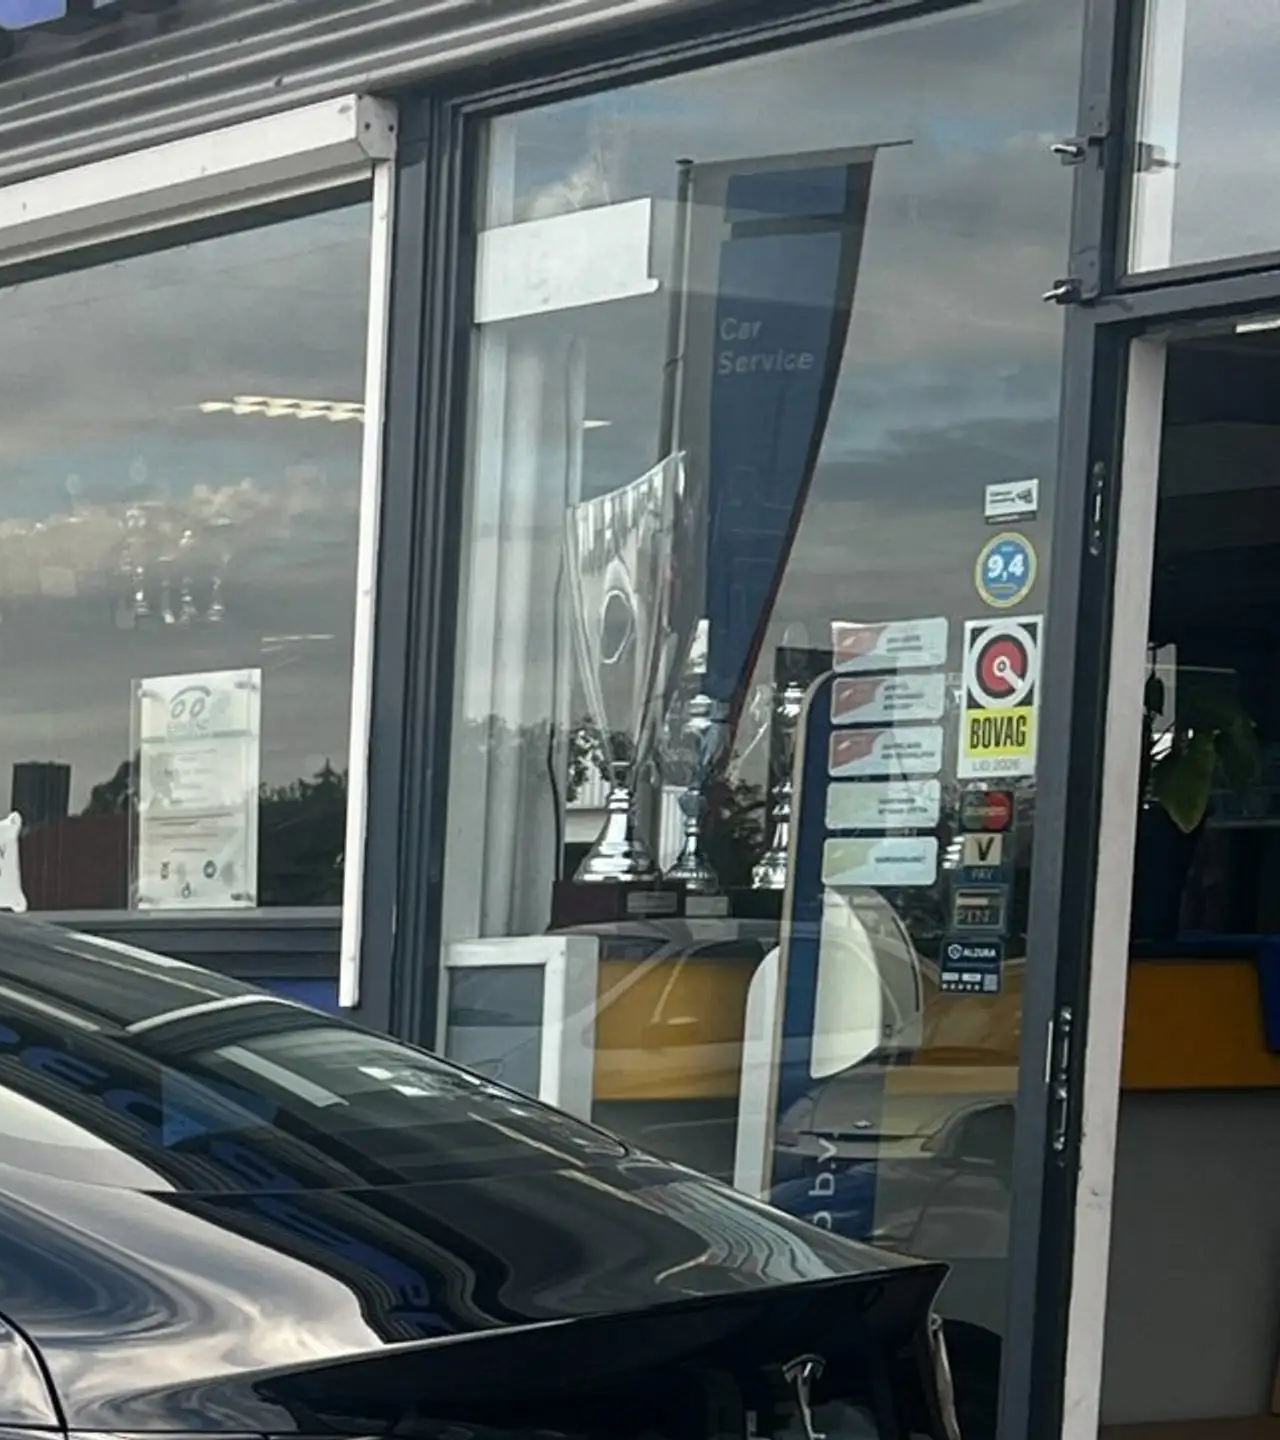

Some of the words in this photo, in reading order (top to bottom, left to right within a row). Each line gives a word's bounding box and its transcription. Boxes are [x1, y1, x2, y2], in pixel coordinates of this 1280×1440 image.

[720, 317, 762, 341] Car
[718, 348, 815, 376] Service
[987, 553, 1025, 581] 9,4
[970, 714, 1027, 750] BOVAG
[975, 836, 995, 861] V
